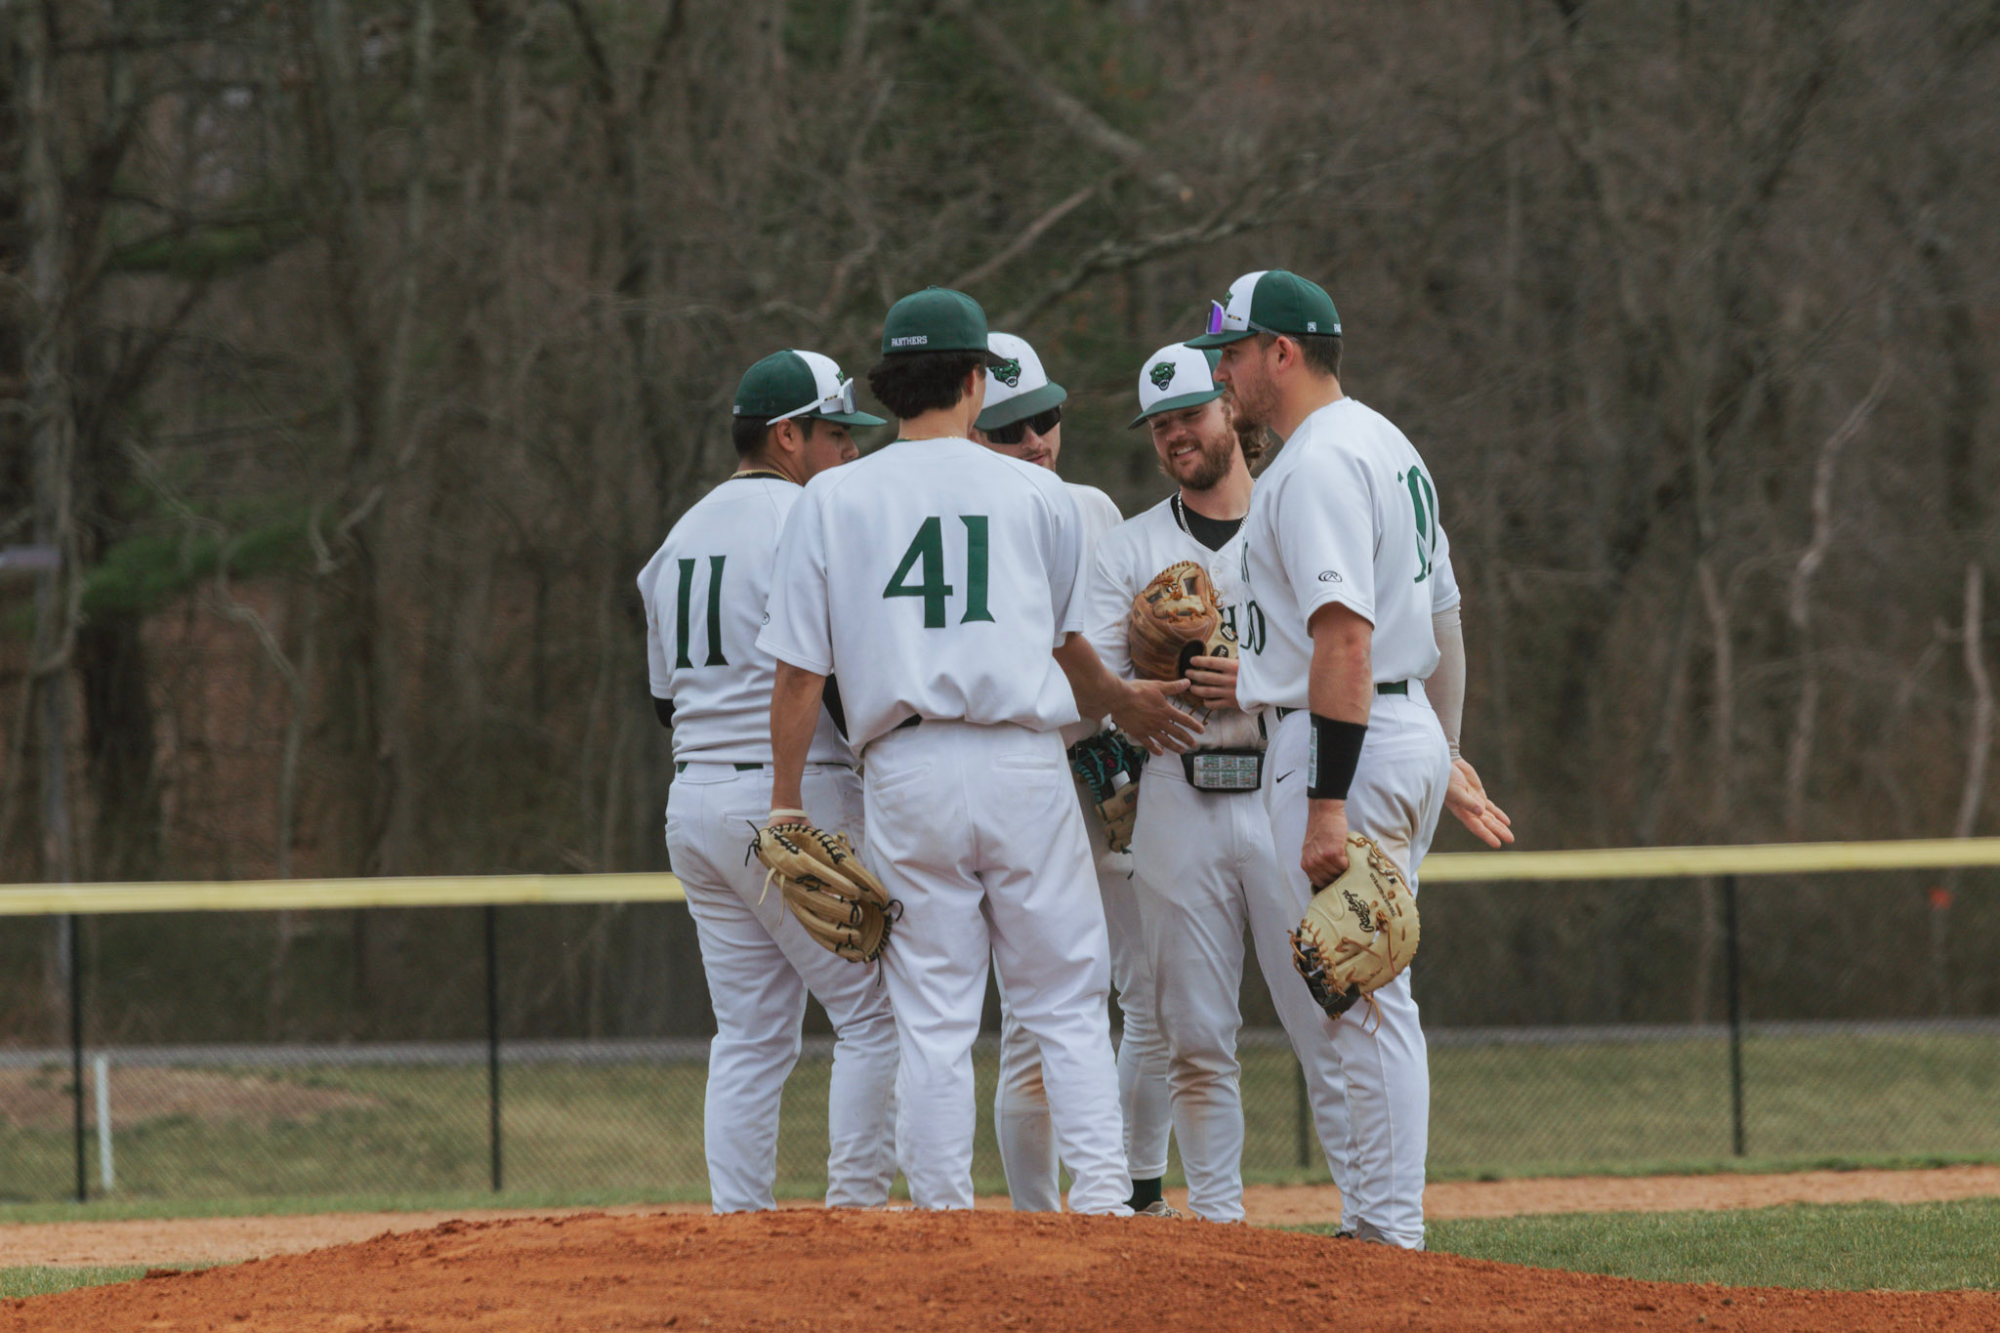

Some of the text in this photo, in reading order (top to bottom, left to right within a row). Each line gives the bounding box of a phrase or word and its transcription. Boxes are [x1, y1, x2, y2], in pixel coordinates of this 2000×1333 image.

[891, 335, 928, 347] PANTHERS
[883, 515, 996, 629] 41
[675, 555, 729, 669] 11
[1342, 889, 1375, 933] Rawlings
